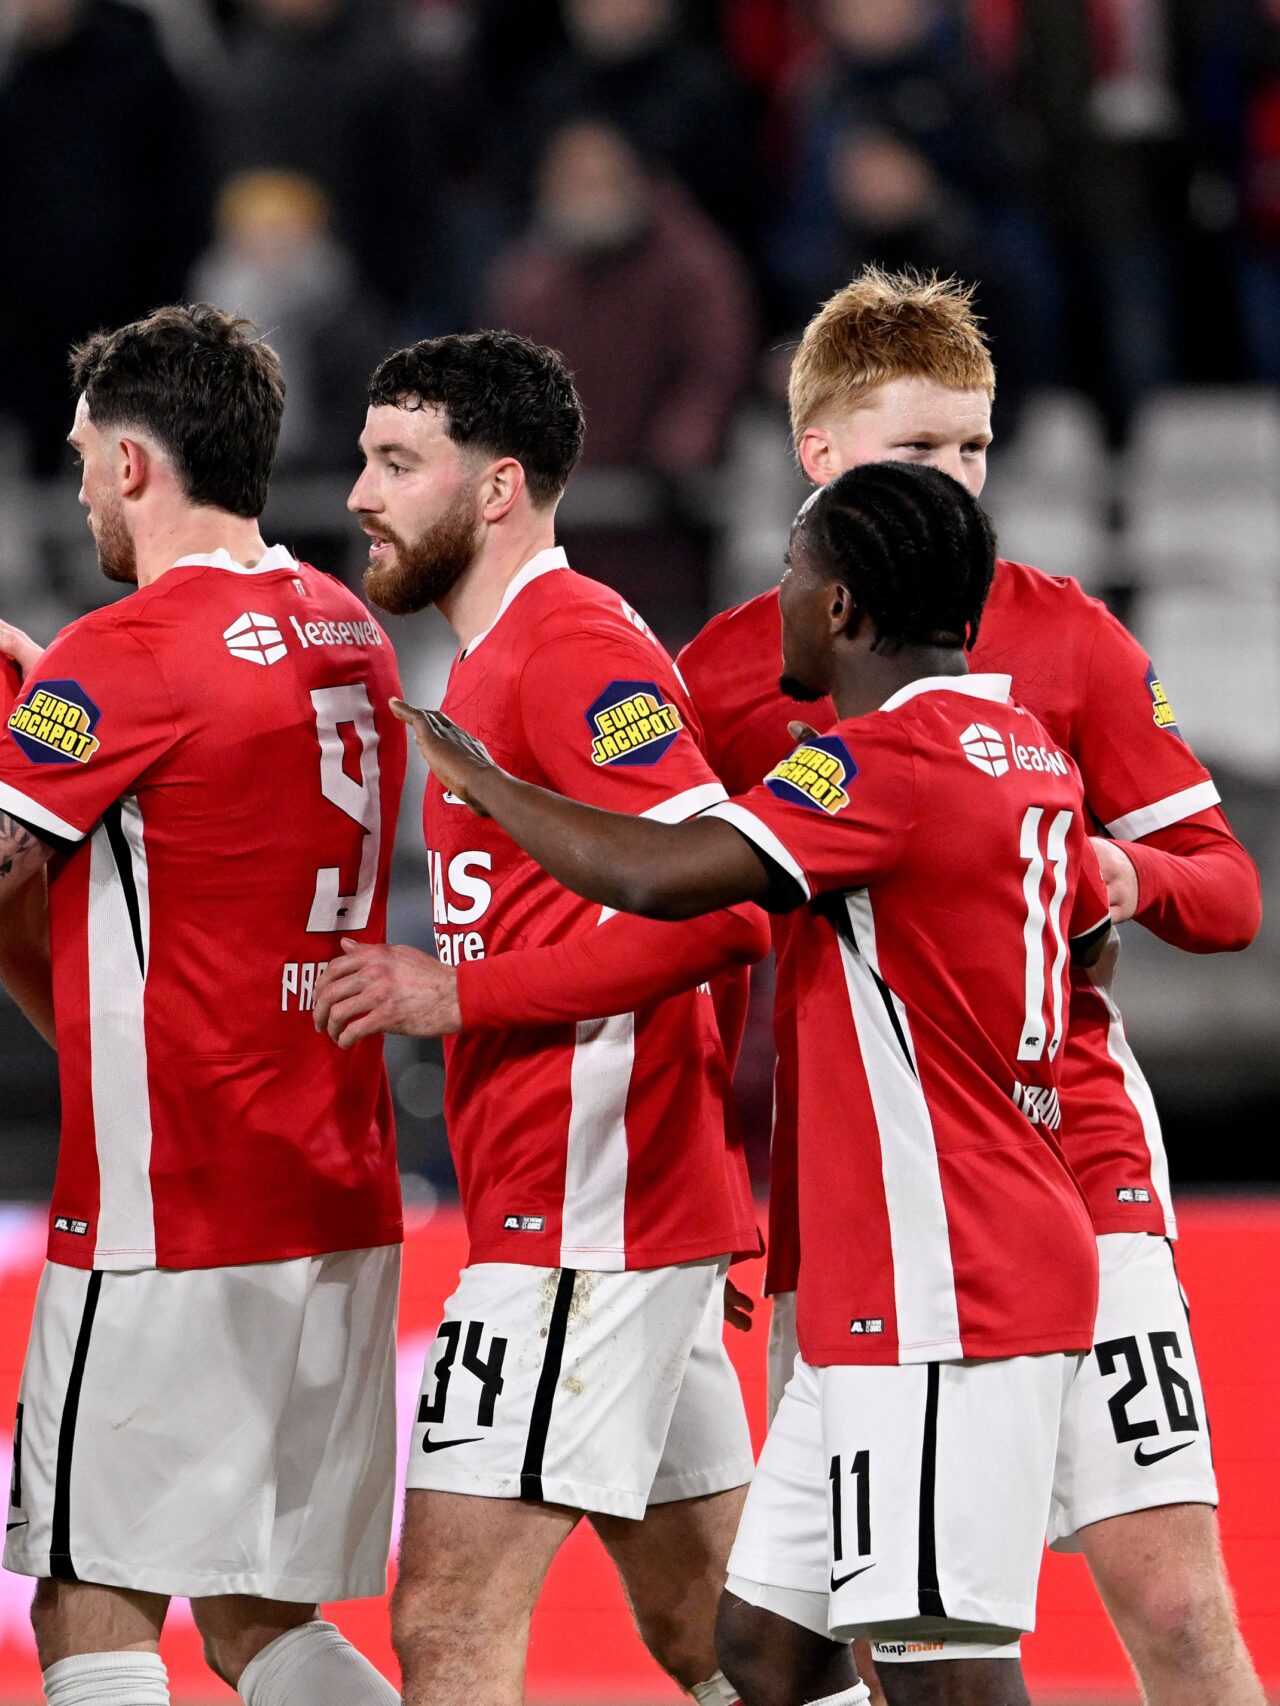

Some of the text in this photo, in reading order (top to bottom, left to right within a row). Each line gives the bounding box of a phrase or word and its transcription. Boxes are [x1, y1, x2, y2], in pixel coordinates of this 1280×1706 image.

[10, 708, 91, 757] JACKPOT
[30, 692, 81, 729] EURO
[594, 708, 675, 762] JACKPOT
[597, 696, 651, 736] EURO
[306, 683, 382, 934] 9
[427, 850, 493, 925] AS
[433, 926, 486, 968] are
[1017, 807, 1074, 1063] 11
[417, 1320, 508, 1428] 34
[1094, 1331, 1200, 1444] 26
[829, 1449, 872, 1562] 11
